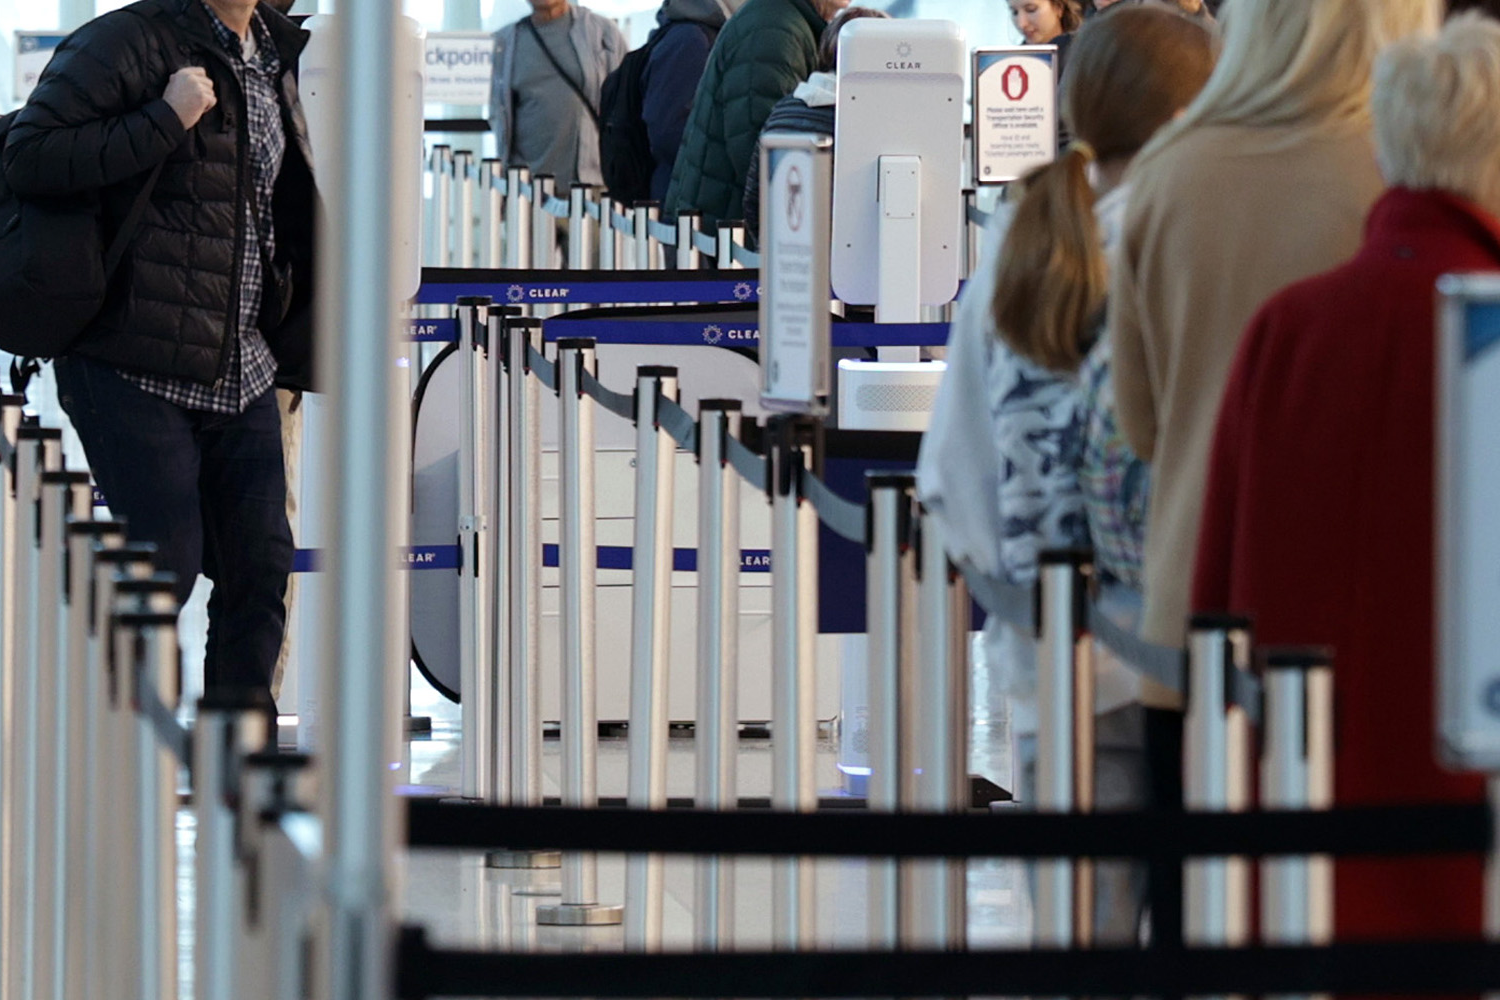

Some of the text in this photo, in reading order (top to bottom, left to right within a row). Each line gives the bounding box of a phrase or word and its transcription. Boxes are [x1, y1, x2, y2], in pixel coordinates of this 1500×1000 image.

[885, 61, 921, 70] CLEAR
[529, 288, 569, 298] CLEAR
[402, 325, 437, 335] LEAR
[728, 329, 760, 340] CLEA
[400, 552, 436, 563] LEAR
